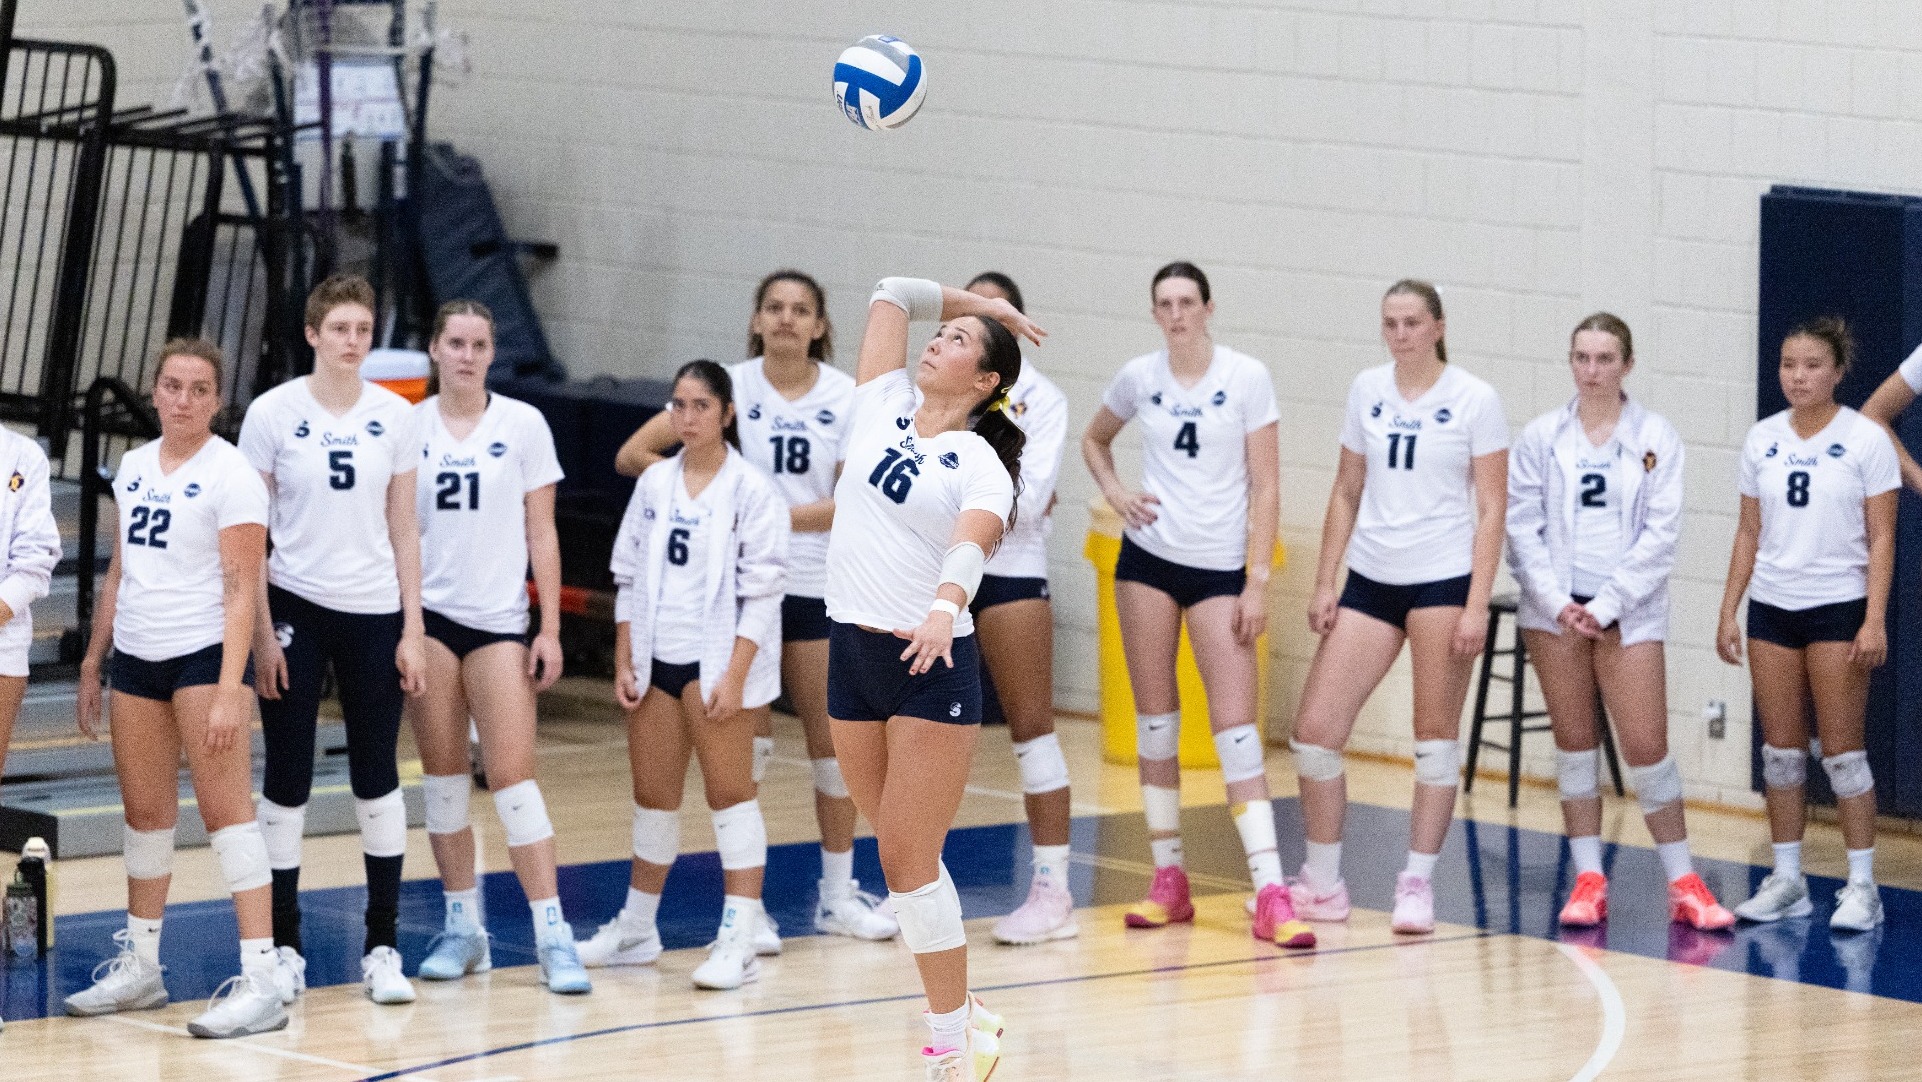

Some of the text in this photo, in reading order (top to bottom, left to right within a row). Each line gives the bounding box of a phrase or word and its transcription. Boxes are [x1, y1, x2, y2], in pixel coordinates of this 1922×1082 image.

[320, 431, 359, 447] Smith
[1173, 421, 1200, 459] 4
[1388, 413, 1423, 430] Smith
[769, 435, 811, 475] 18
[900, 435, 927, 465] Smith
[1387, 433, 1418, 471] 11
[1783, 453, 1819, 467] Smith
[328, 450, 356, 490] 5
[868, 447, 921, 505] 16
[1787, 470, 1811, 508] 8
[436, 471, 480, 511] 21
[1581, 473, 1607, 508] 2
[127, 505, 172, 550] 22
[668, 527, 691, 567] 6
